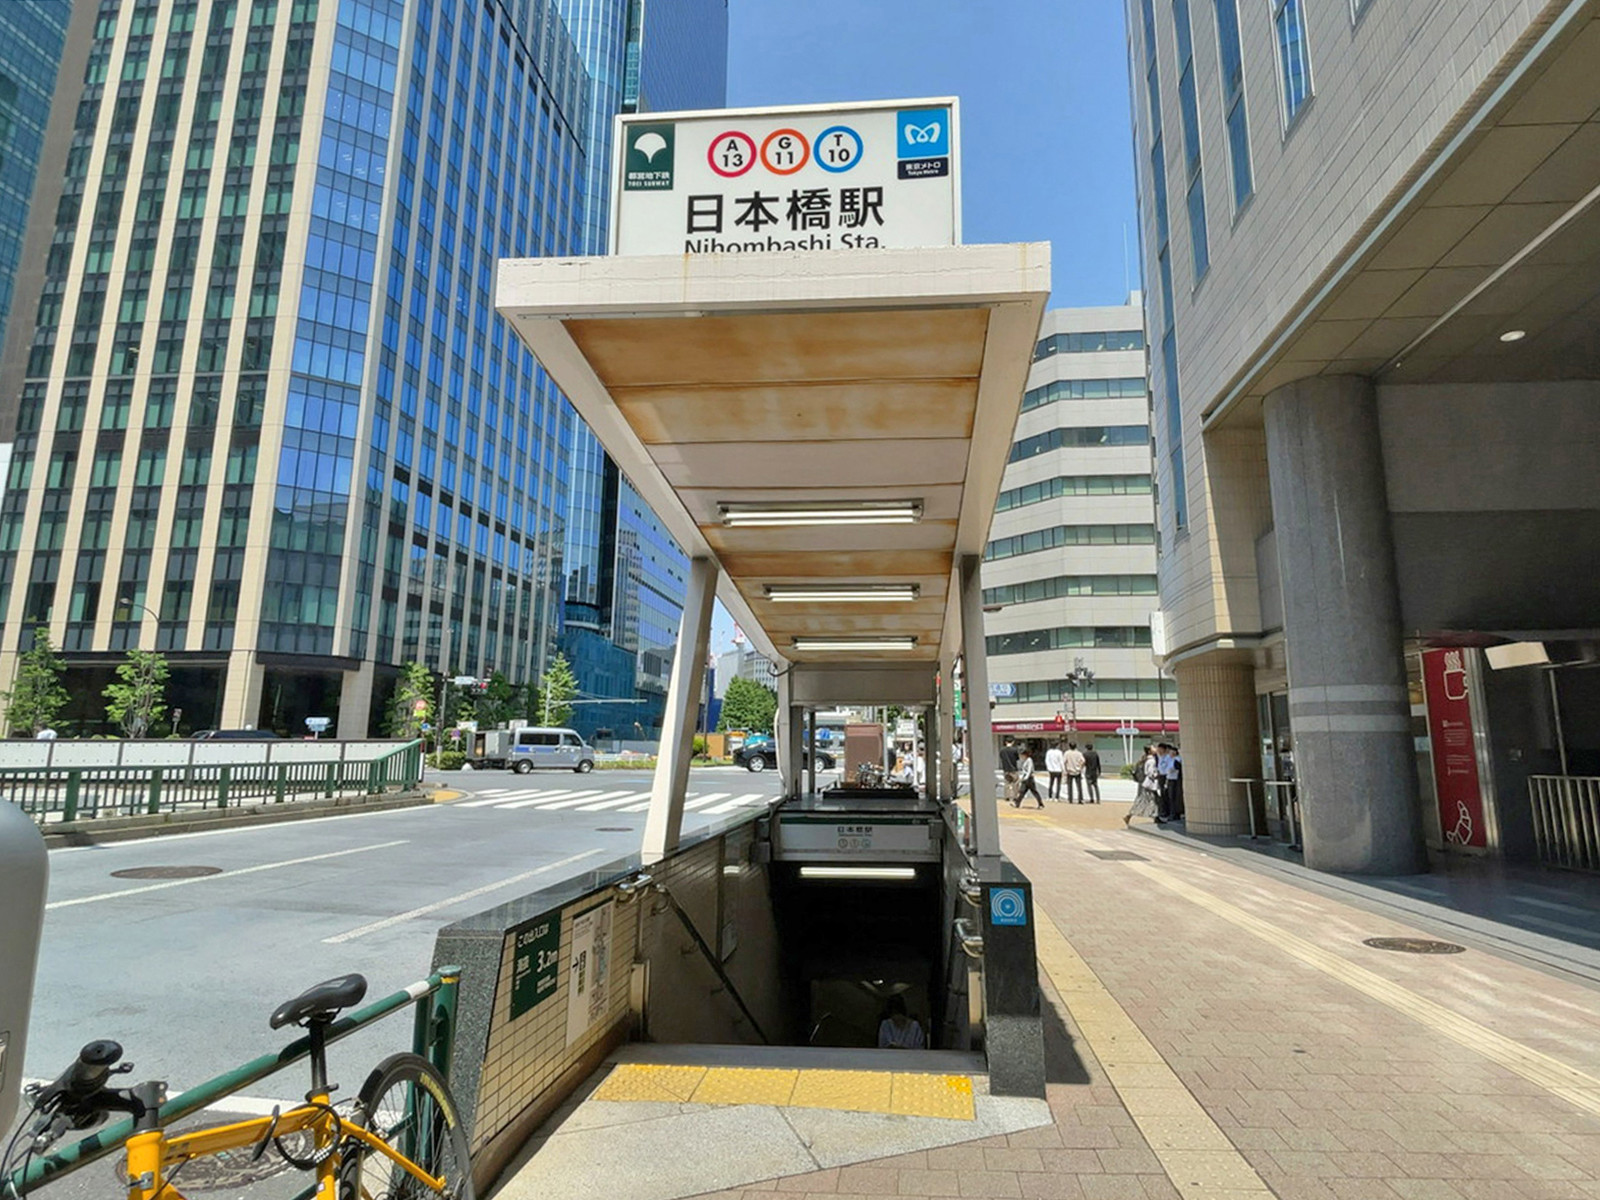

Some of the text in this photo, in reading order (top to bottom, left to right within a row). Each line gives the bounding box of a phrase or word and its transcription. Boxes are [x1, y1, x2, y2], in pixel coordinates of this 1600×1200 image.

[726, 139, 739, 151] A
[778, 137, 792, 149] G
[833, 134, 843, 147] T
[722, 154, 744, 167] 13
[775, 152, 794, 165] 11
[828, 149, 850, 163] 10
[905, 161, 941, 170] 東京メトロ
[686, 186, 885, 234] 日本橋駅
